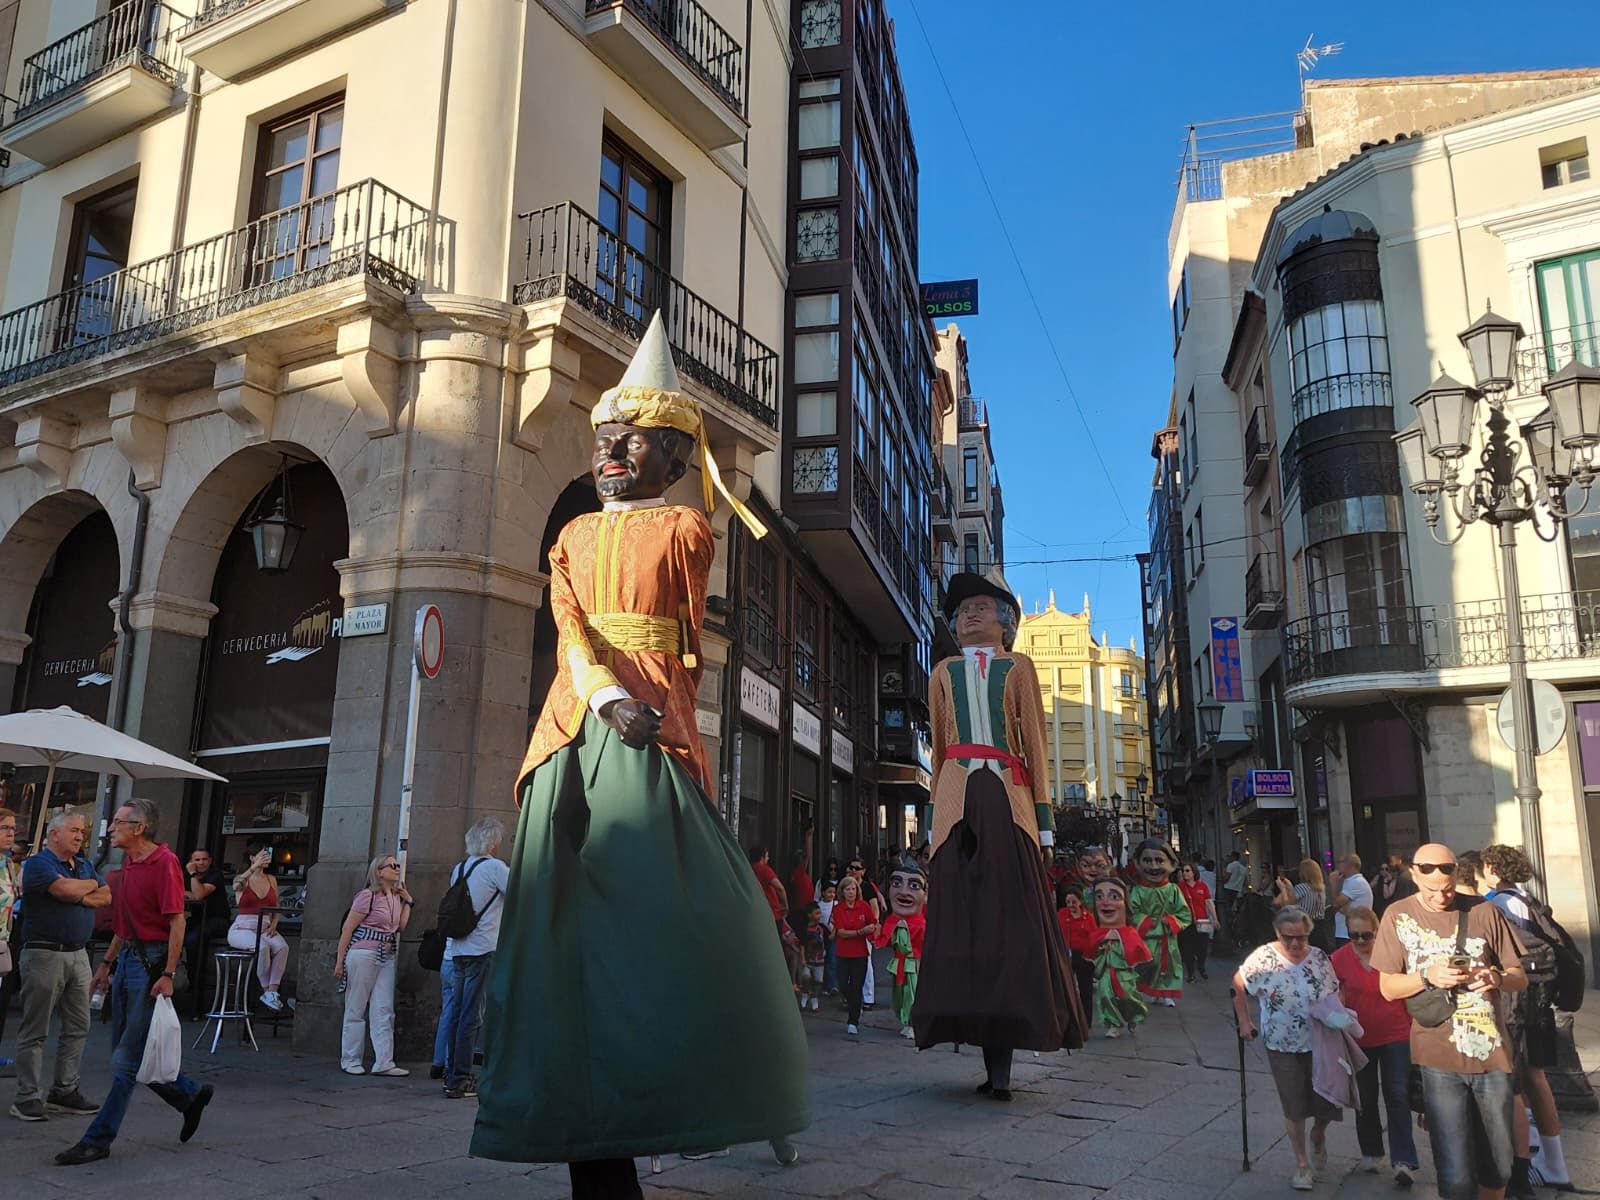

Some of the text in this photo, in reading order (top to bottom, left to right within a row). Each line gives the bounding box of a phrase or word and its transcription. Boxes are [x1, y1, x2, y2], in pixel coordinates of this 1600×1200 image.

[926, 301, 972, 314] OLSOS
[355, 608, 383, 619] PLAZA
[354, 619, 382, 630] MAYOR
